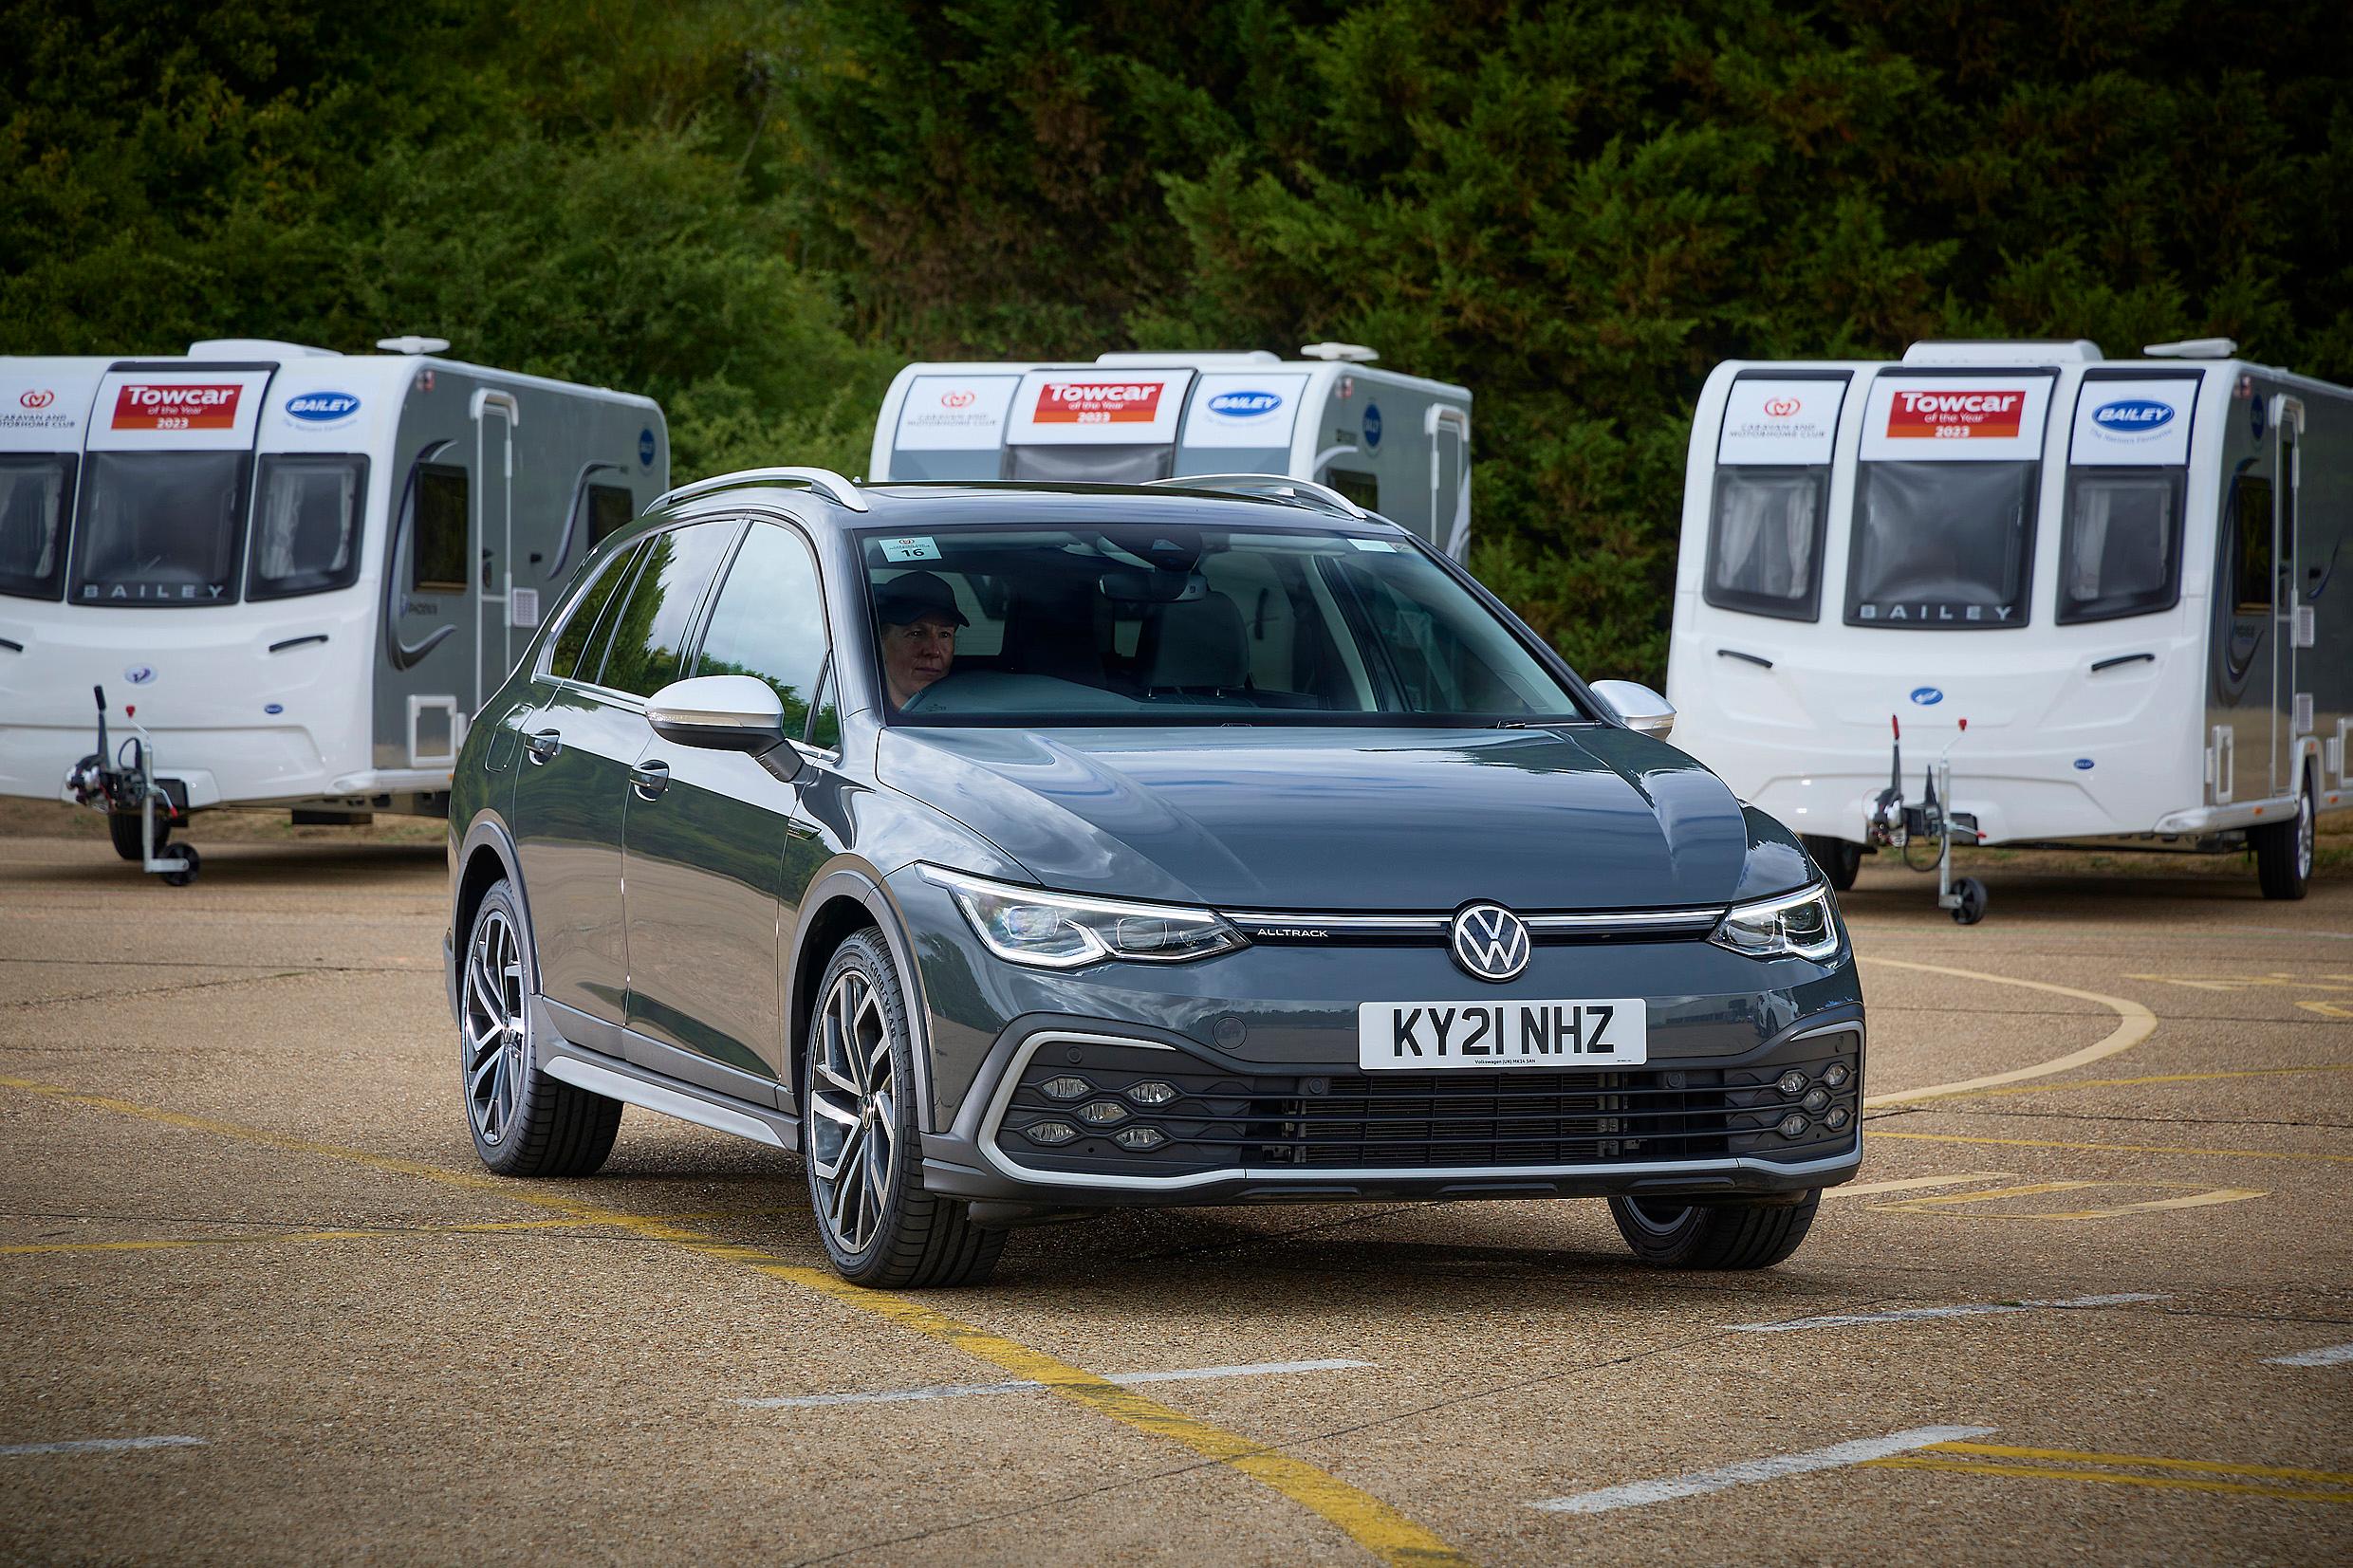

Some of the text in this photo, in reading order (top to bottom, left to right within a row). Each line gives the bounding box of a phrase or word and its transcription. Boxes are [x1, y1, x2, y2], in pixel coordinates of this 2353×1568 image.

[128, 386, 234, 405] Towcar
[1048, 383, 1157, 401] Towcar
[290, 399, 357, 412] BAILEY
[1900, 392, 2017, 413] Towcar
[147, 405, 202, 415] of the Year
[2098, 407, 2169, 421] BAILEY
[157, 417, 189, 430] 2023
[1924, 413, 1984, 423] of the Year
[1936, 425, 1971, 437] 2023
[901, 548, 925, 557] 16
[83, 584, 224, 599] BAILEY
[1860, 604, 2011, 620] BAILEY
[1257, 928, 1328, 937] ALLTRACK
[1393, 1005, 1615, 1057] KY21 NHZ
